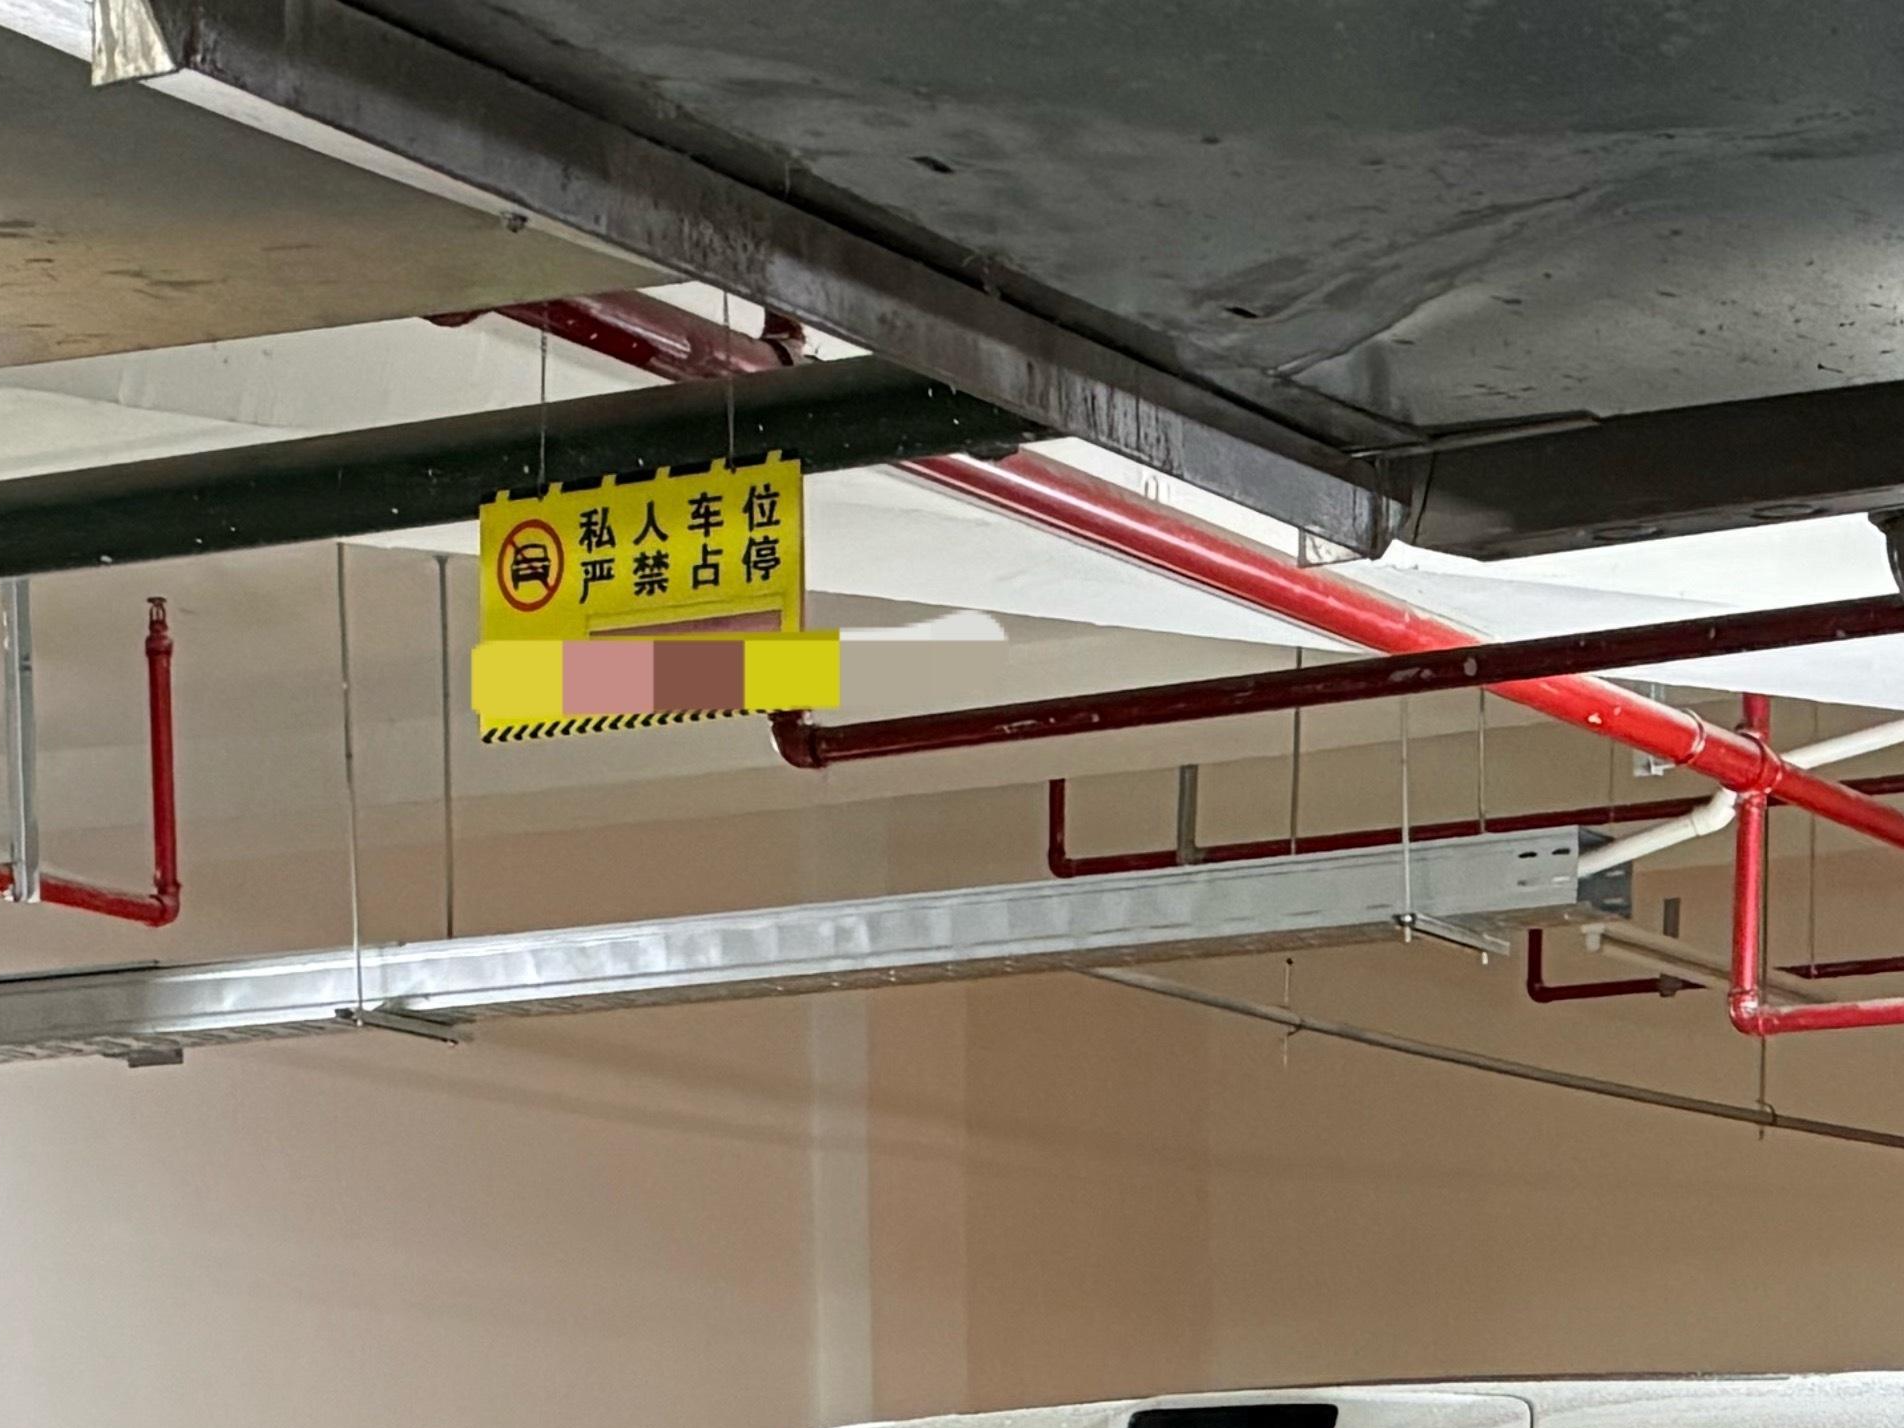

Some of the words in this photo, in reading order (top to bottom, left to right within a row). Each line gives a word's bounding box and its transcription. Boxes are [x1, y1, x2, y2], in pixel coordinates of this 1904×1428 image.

[578, 483, 782, 554] 私人车位
[578, 534, 782, 605] 严禁占停
